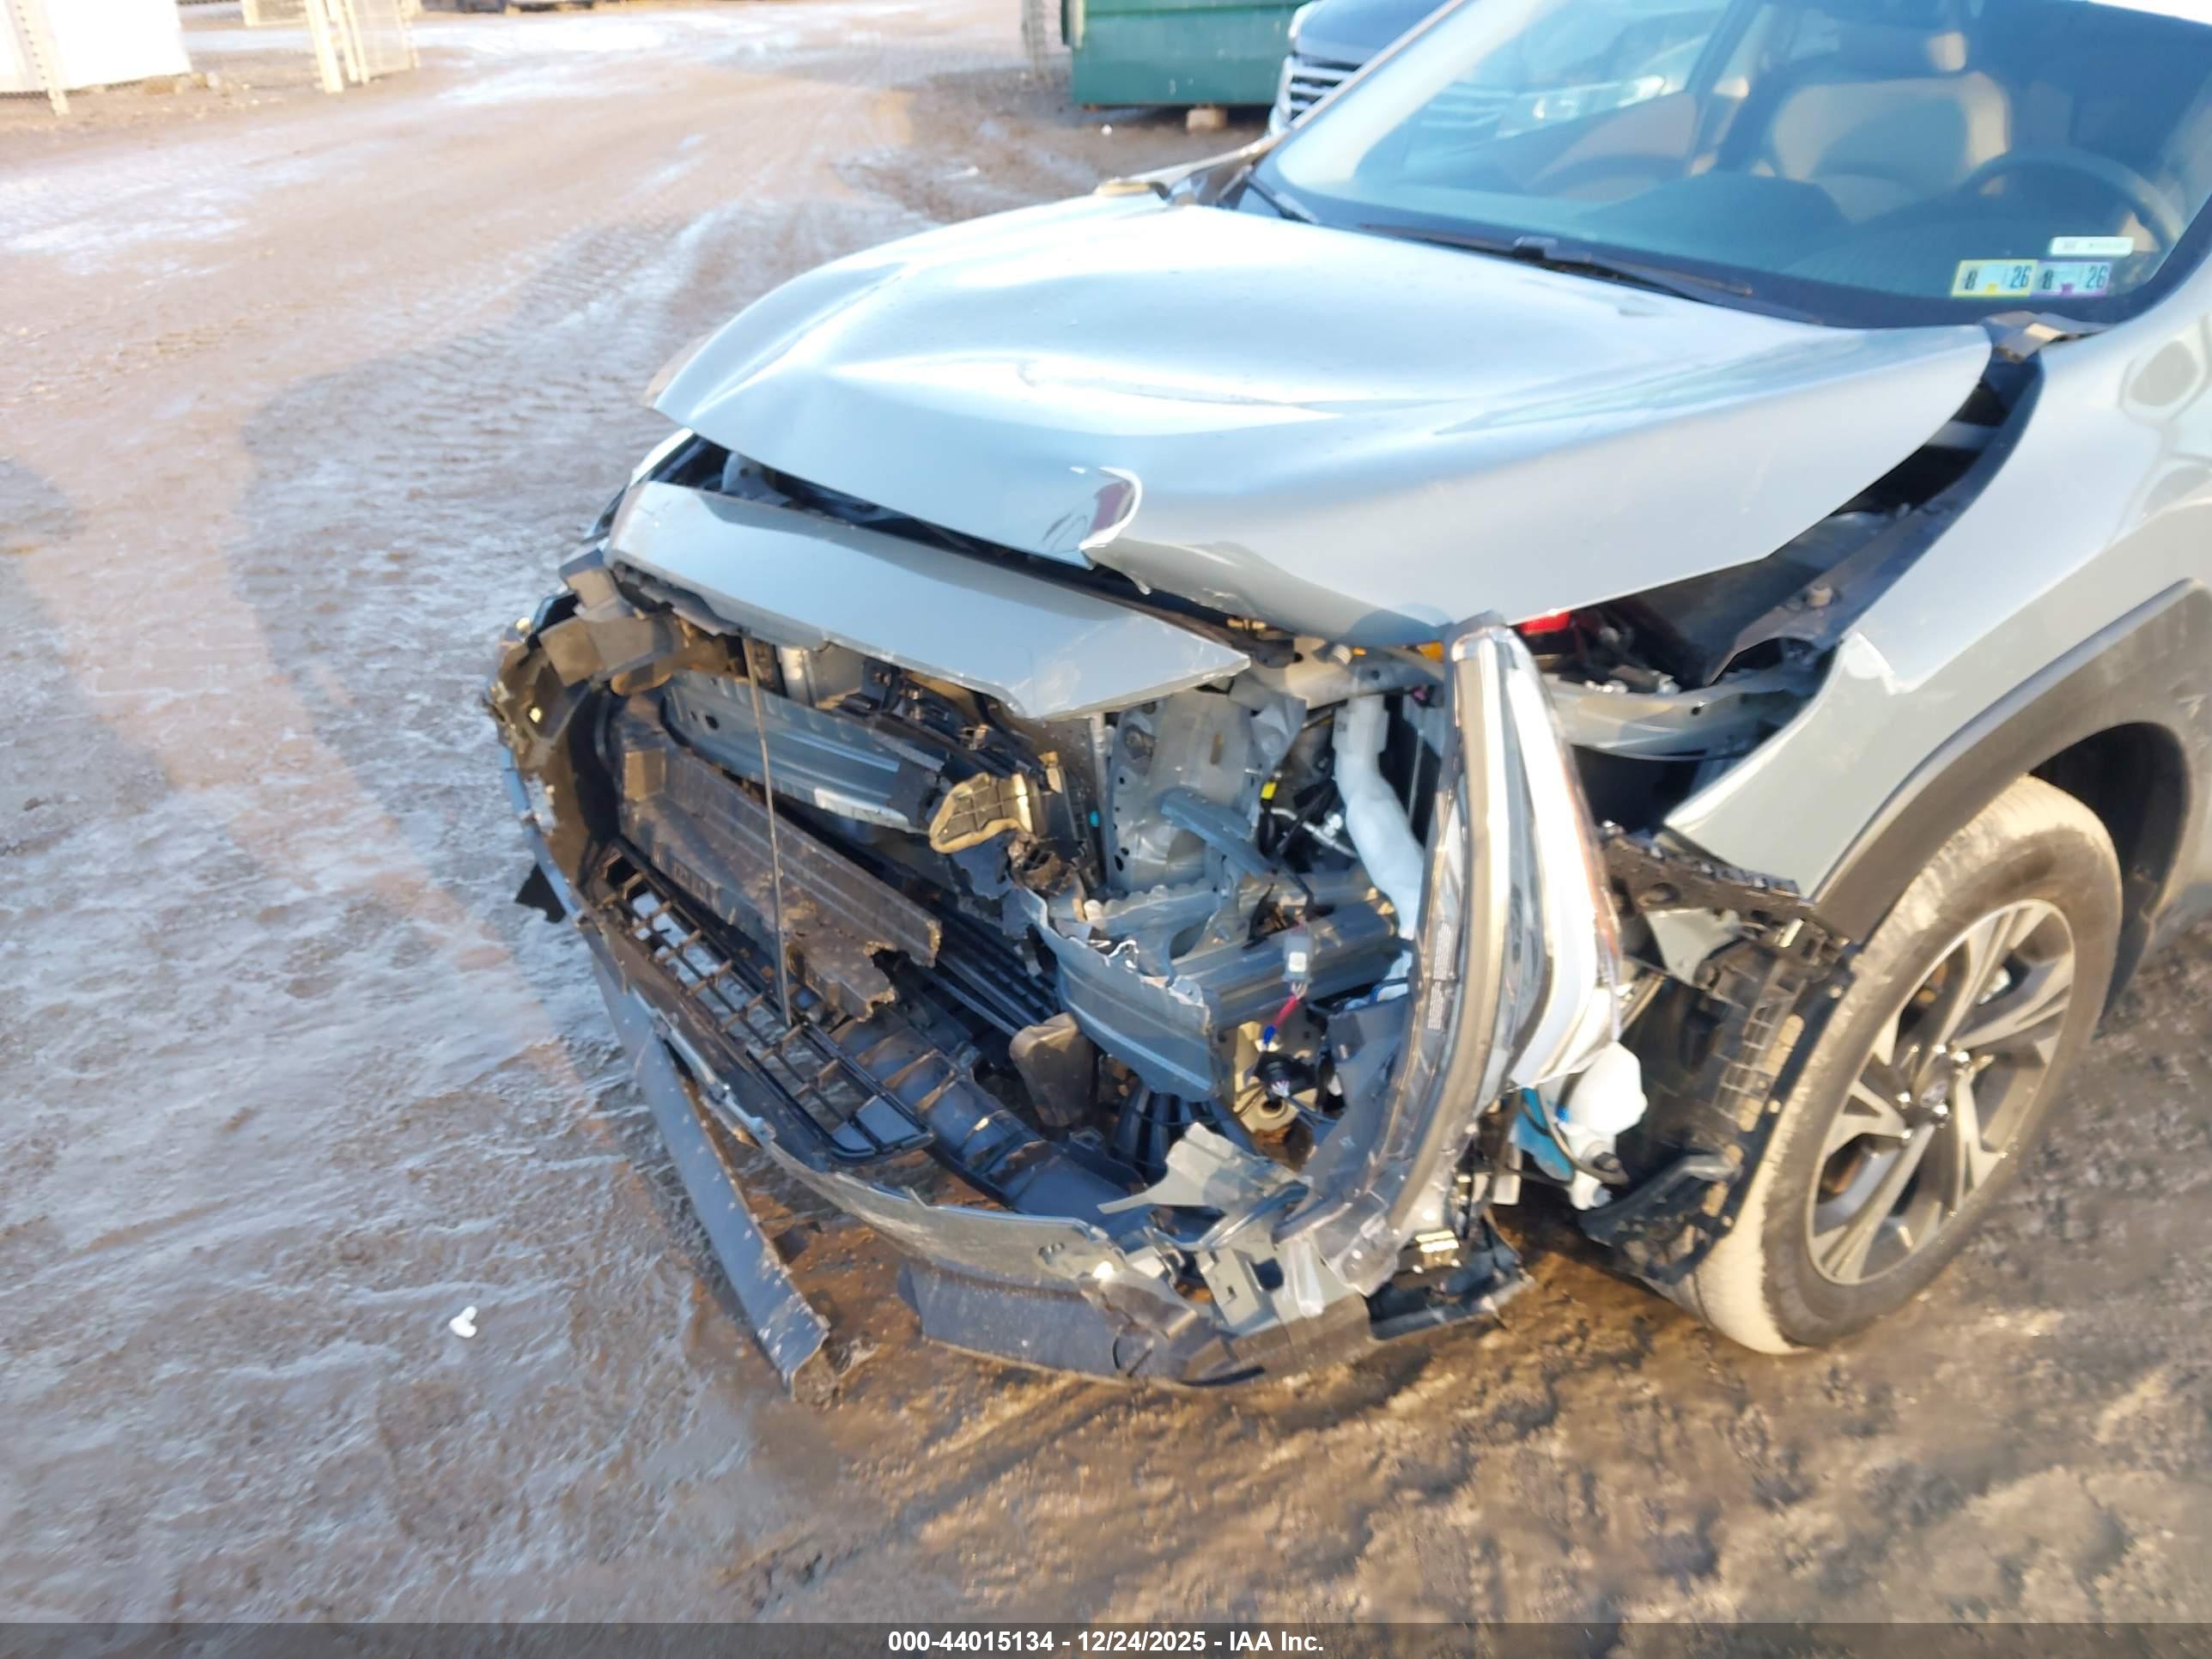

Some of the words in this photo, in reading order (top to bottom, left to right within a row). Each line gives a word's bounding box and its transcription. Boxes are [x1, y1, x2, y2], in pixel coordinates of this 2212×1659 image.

[1965, 270, 1978, 289] 8
[2009, 264, 2032, 289] 26
[2086, 265, 2108, 289] 26
